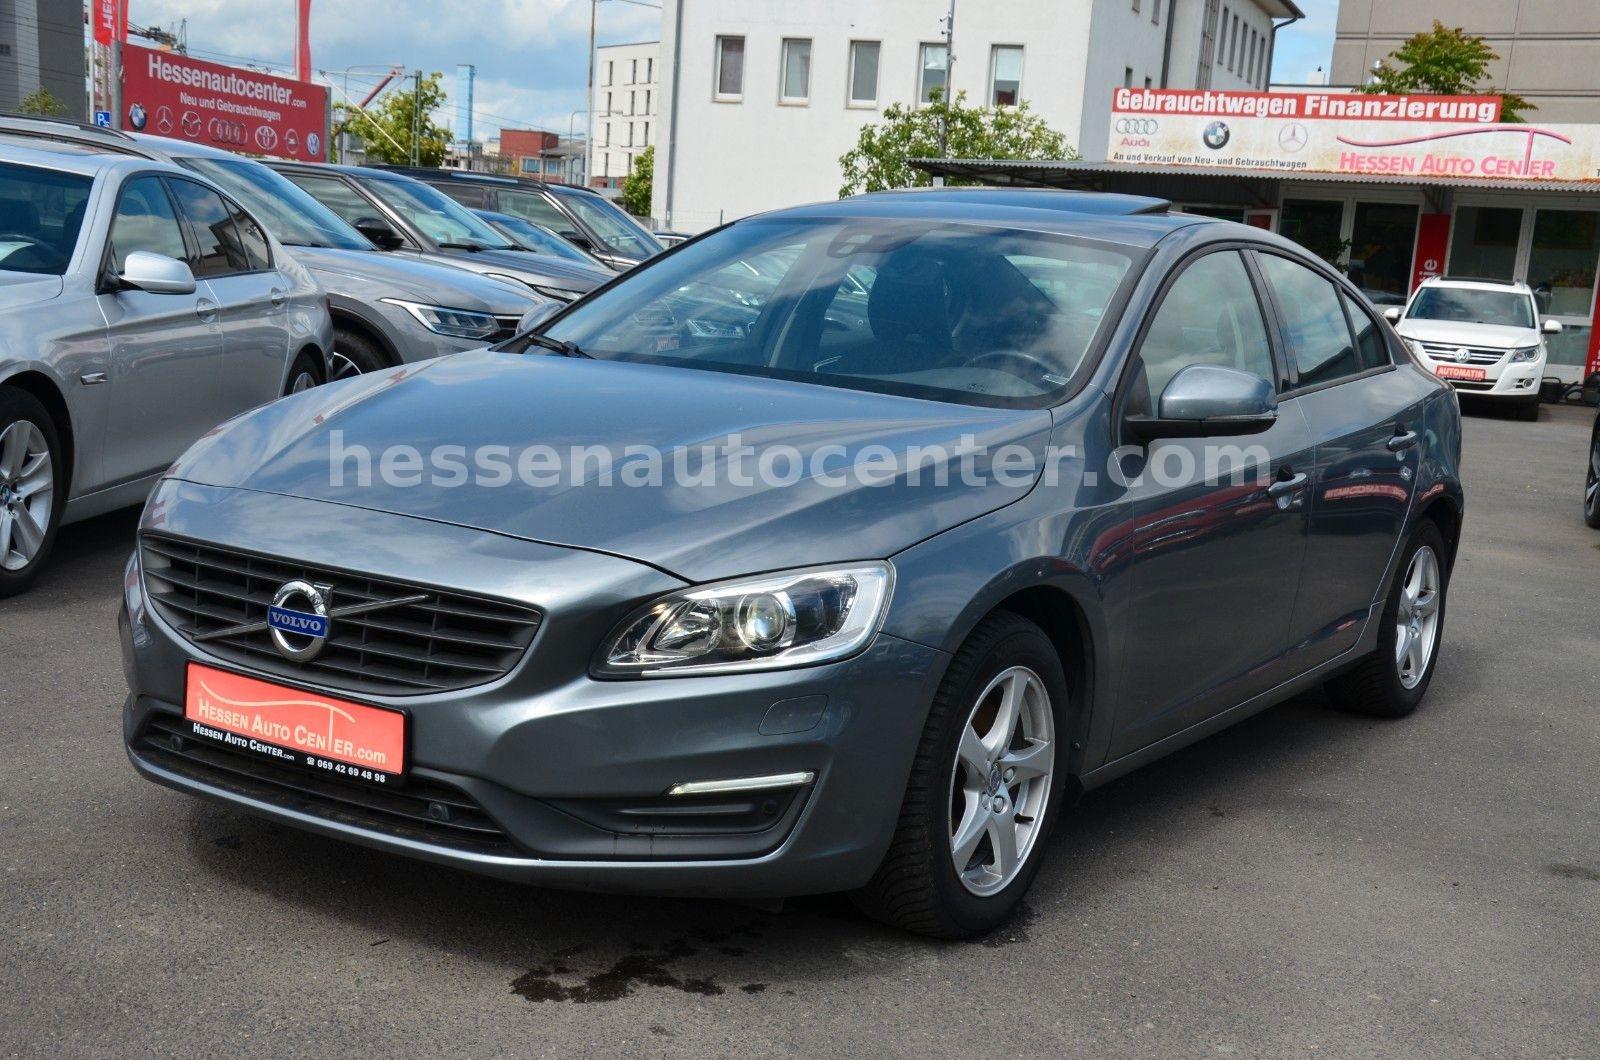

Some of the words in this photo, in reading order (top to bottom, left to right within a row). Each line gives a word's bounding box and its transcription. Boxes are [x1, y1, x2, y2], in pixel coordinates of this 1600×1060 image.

[180, 92, 198, 106] Neu
[199, 97, 215, 108] und
[217, 99, 281, 122] Gebrauchtwagen
[1117, 89, 1297, 117] Gebrauchtwagen
[1305, 95, 1496, 121] Finanzierung
[1120, 137, 1150, 147] Audi
[1113, 152, 1124, 161] An
[1126, 153, 1141, 161] und
[1144, 154, 1175, 163] Verkauf
[1177, 156, 1192, 164] von
[1194, 156, 1215, 165] Neu-
[1217, 157, 1233, 166] und
[1235, 158, 1307, 169] Gebrauchtwagen
[1339, 152, 1416, 173] HESSEN
[1420, 154, 1475, 174] AUTO
[1438, 367, 1484, 378] AUTOMATIK
[271, 611, 322, 631] VOLVO
[198, 698, 249, 731] HESSEN
[251, 715, 290, 741] AUTO
[193, 722, 223, 741] HESSEN
[225, 732, 247, 748] AUTO
[317, 759, 333, 771] 069
[335, 763, 346, 774] 42
[348, 766, 359, 777] 69
[361, 769, 372, 780] 48
[374, 772, 386, 783] 98
